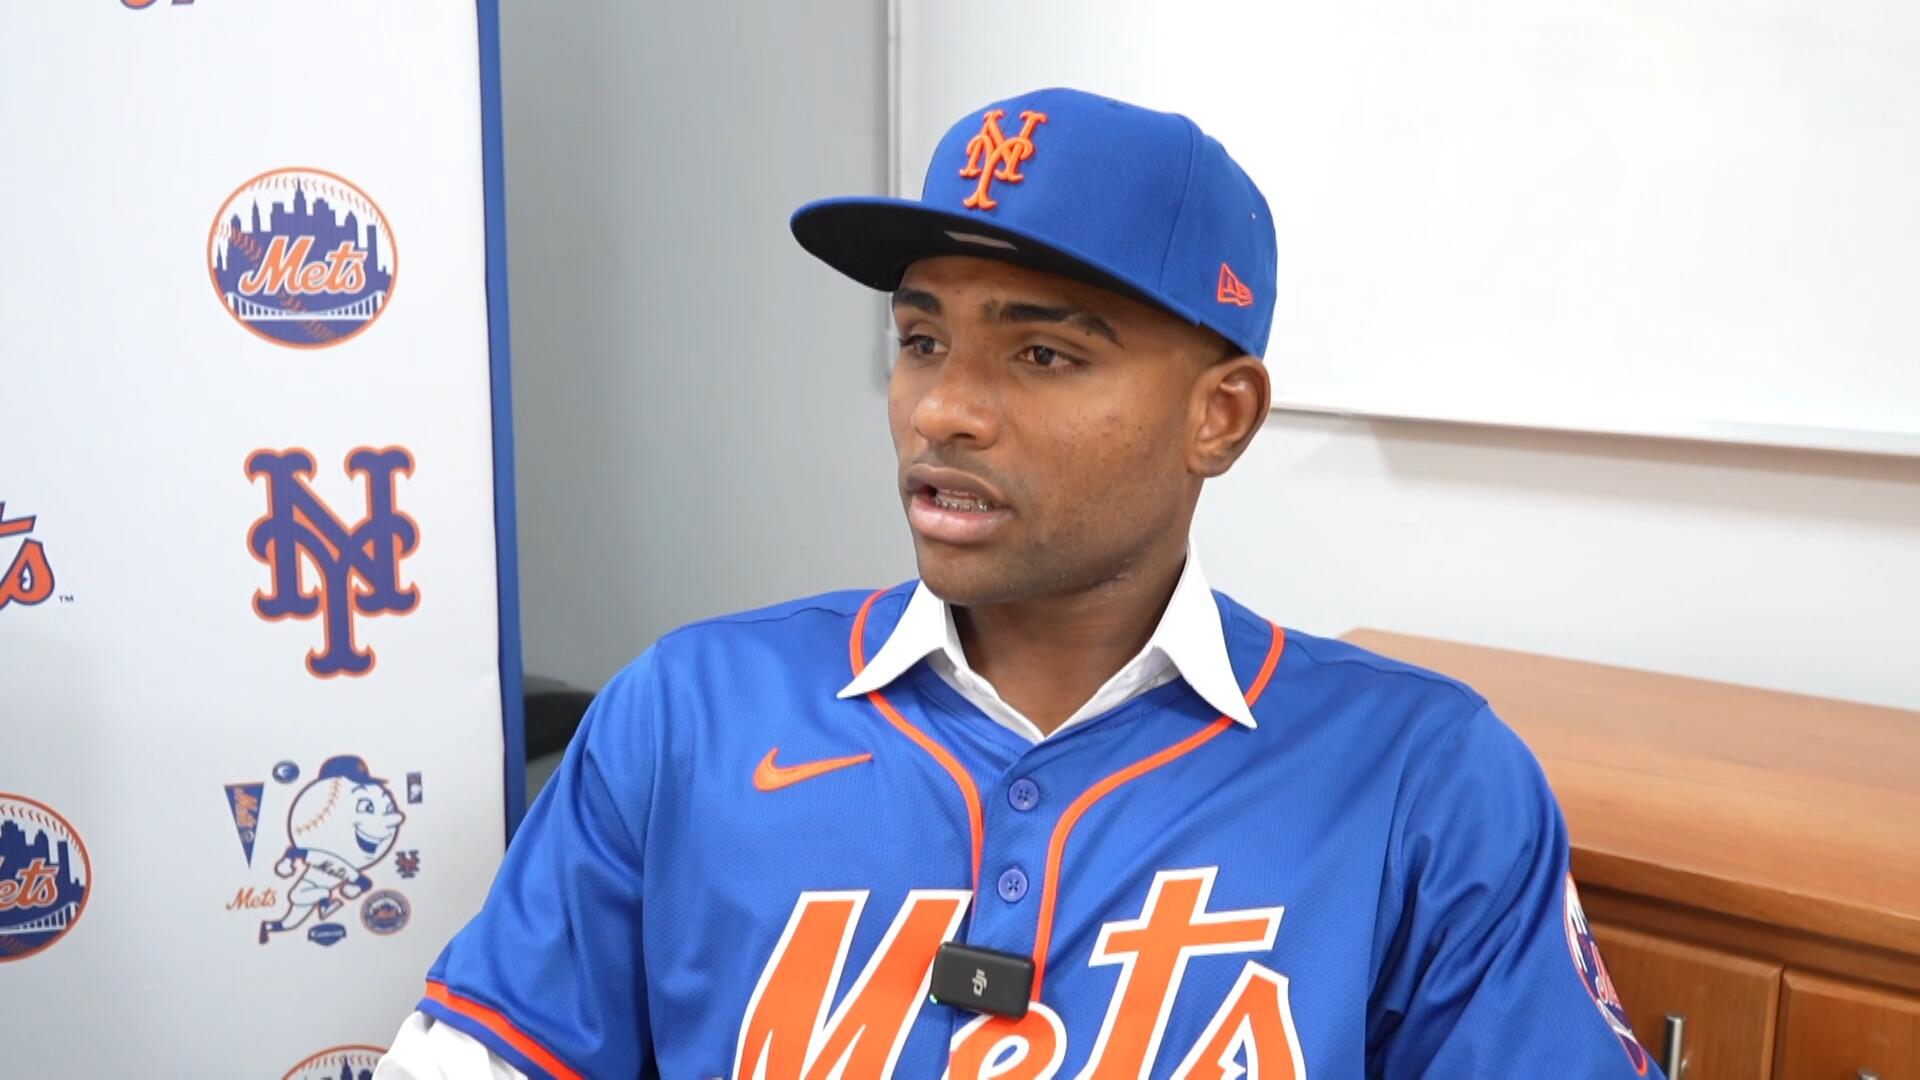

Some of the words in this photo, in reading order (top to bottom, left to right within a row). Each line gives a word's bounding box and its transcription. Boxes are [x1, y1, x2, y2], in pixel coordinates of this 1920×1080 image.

[238, 235, 368, 295] Mets
[244, 445, 421, 679] NY
[0, 856, 60, 911] ets
[225, 887, 277, 911] Mets
